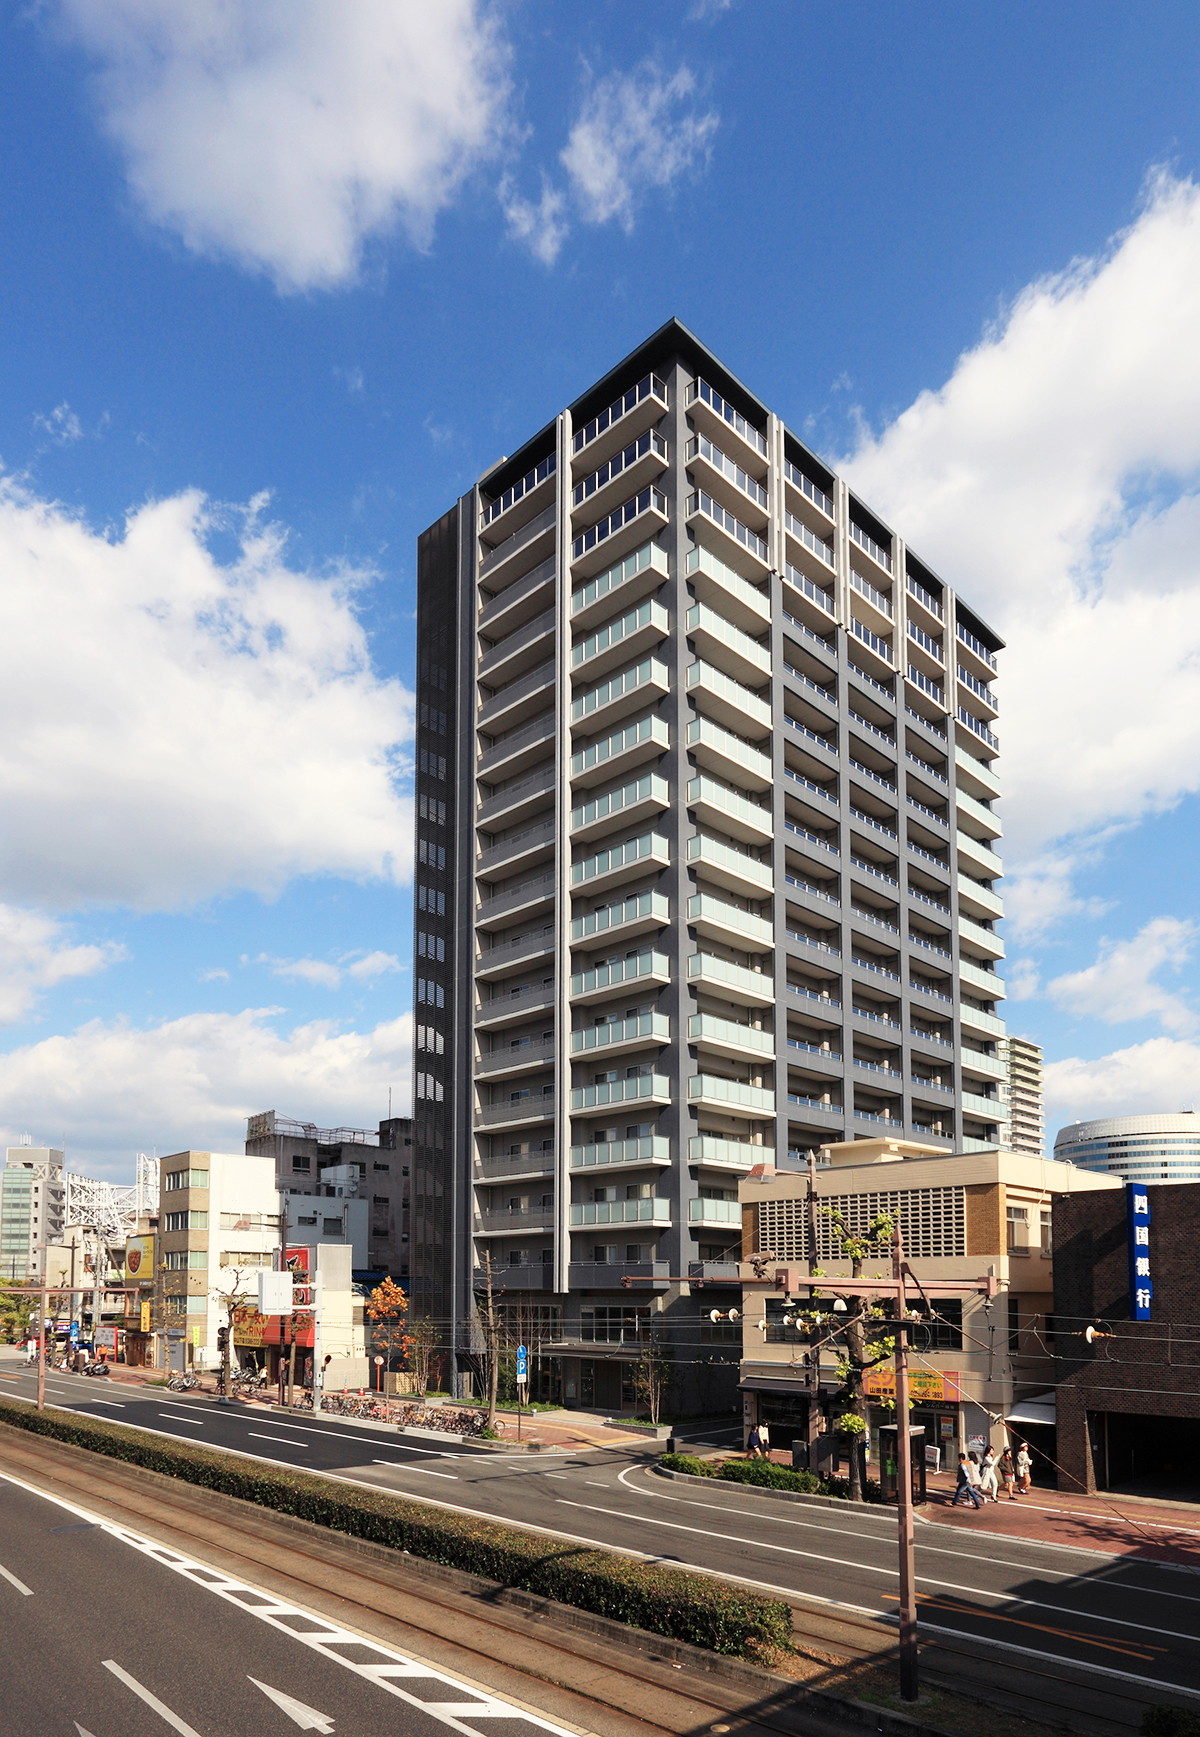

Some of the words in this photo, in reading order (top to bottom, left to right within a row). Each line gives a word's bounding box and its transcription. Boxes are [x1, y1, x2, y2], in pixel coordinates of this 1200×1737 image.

[1134, 1194, 1151, 1309] 四国銀行
[520, 1362, 525, 1374] P
